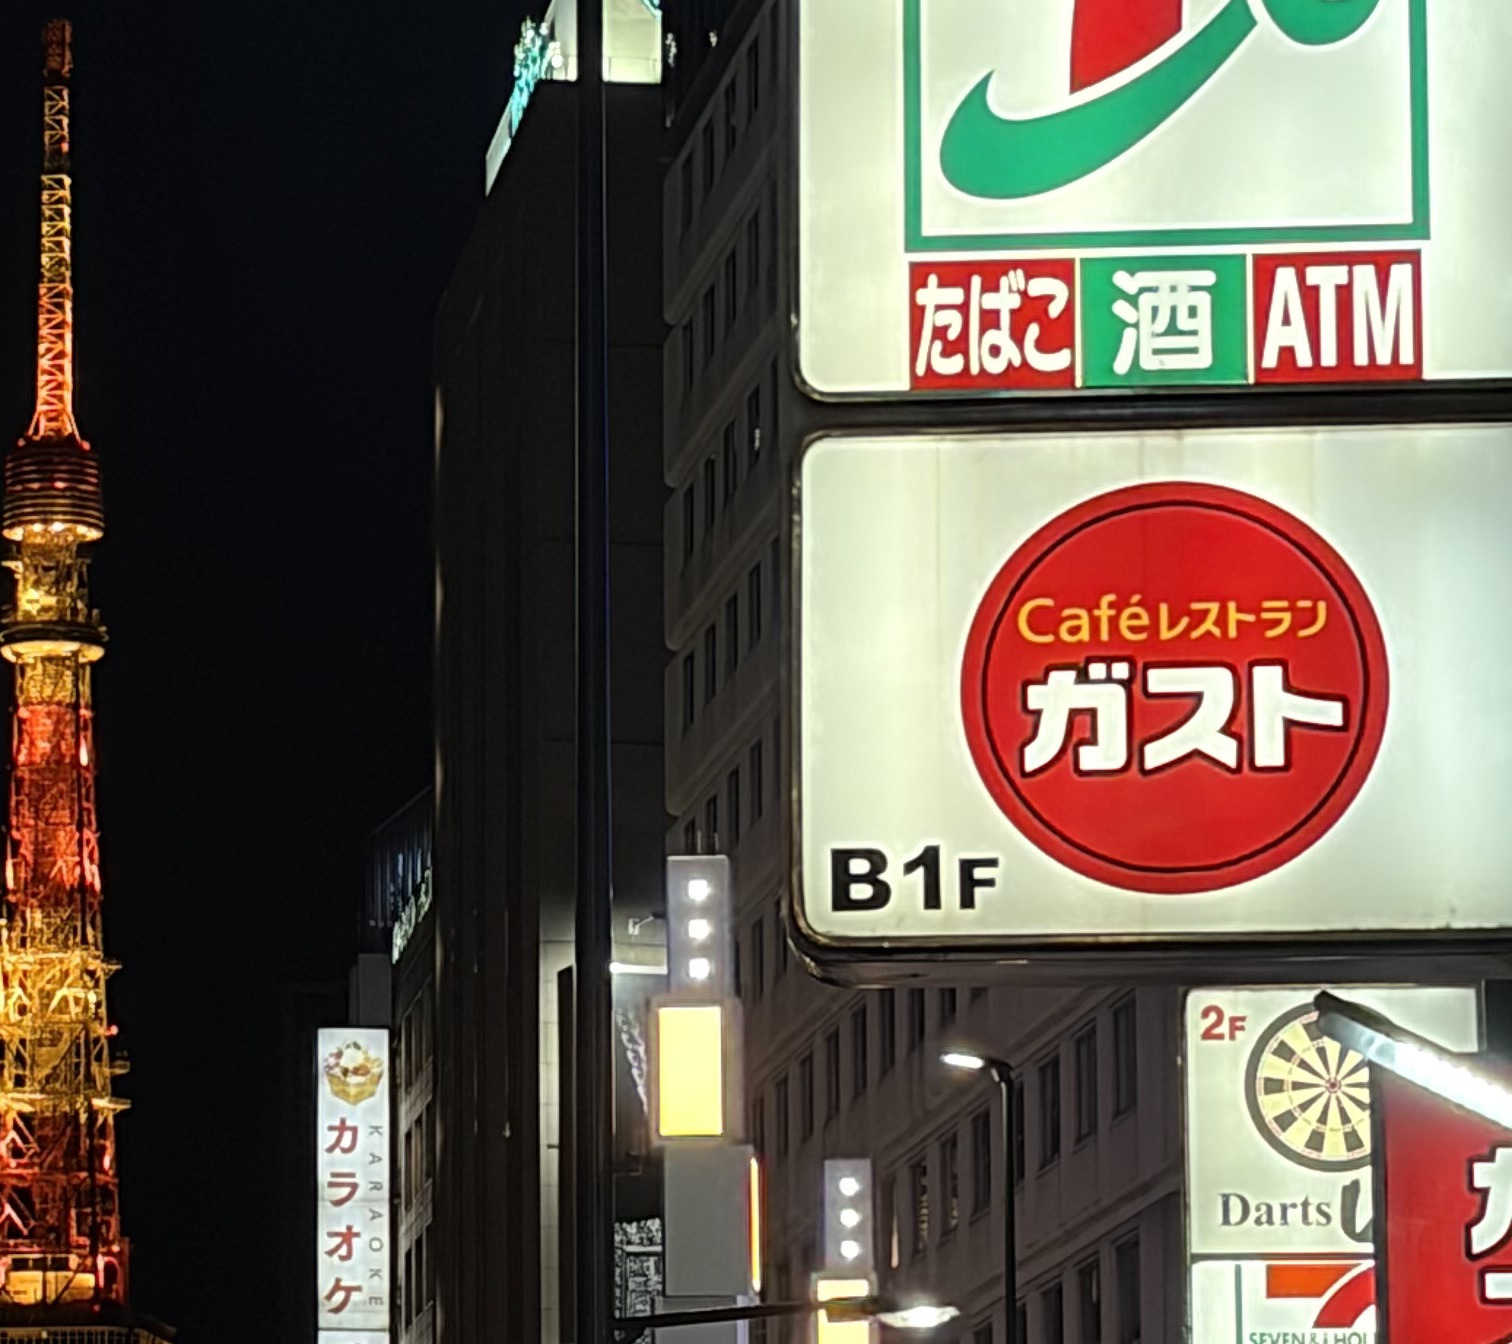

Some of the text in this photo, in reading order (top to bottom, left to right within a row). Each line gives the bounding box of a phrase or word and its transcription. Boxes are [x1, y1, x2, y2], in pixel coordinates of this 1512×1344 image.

[914, 273, 1072, 378] たばこ
[1112, 270, 1217, 372] 酒
[1262, 263, 1414, 369] ATM
[1022, 659, 1347, 775] ガスト
[830, 845, 999, 912] B1F
[1200, 1006, 1247, 1041] 2F
[324, 1117, 363, 1314] カラオケ
[368, 1125, 384, 1305] KARAOKE
[1219, 1192, 1332, 1227] Darts
